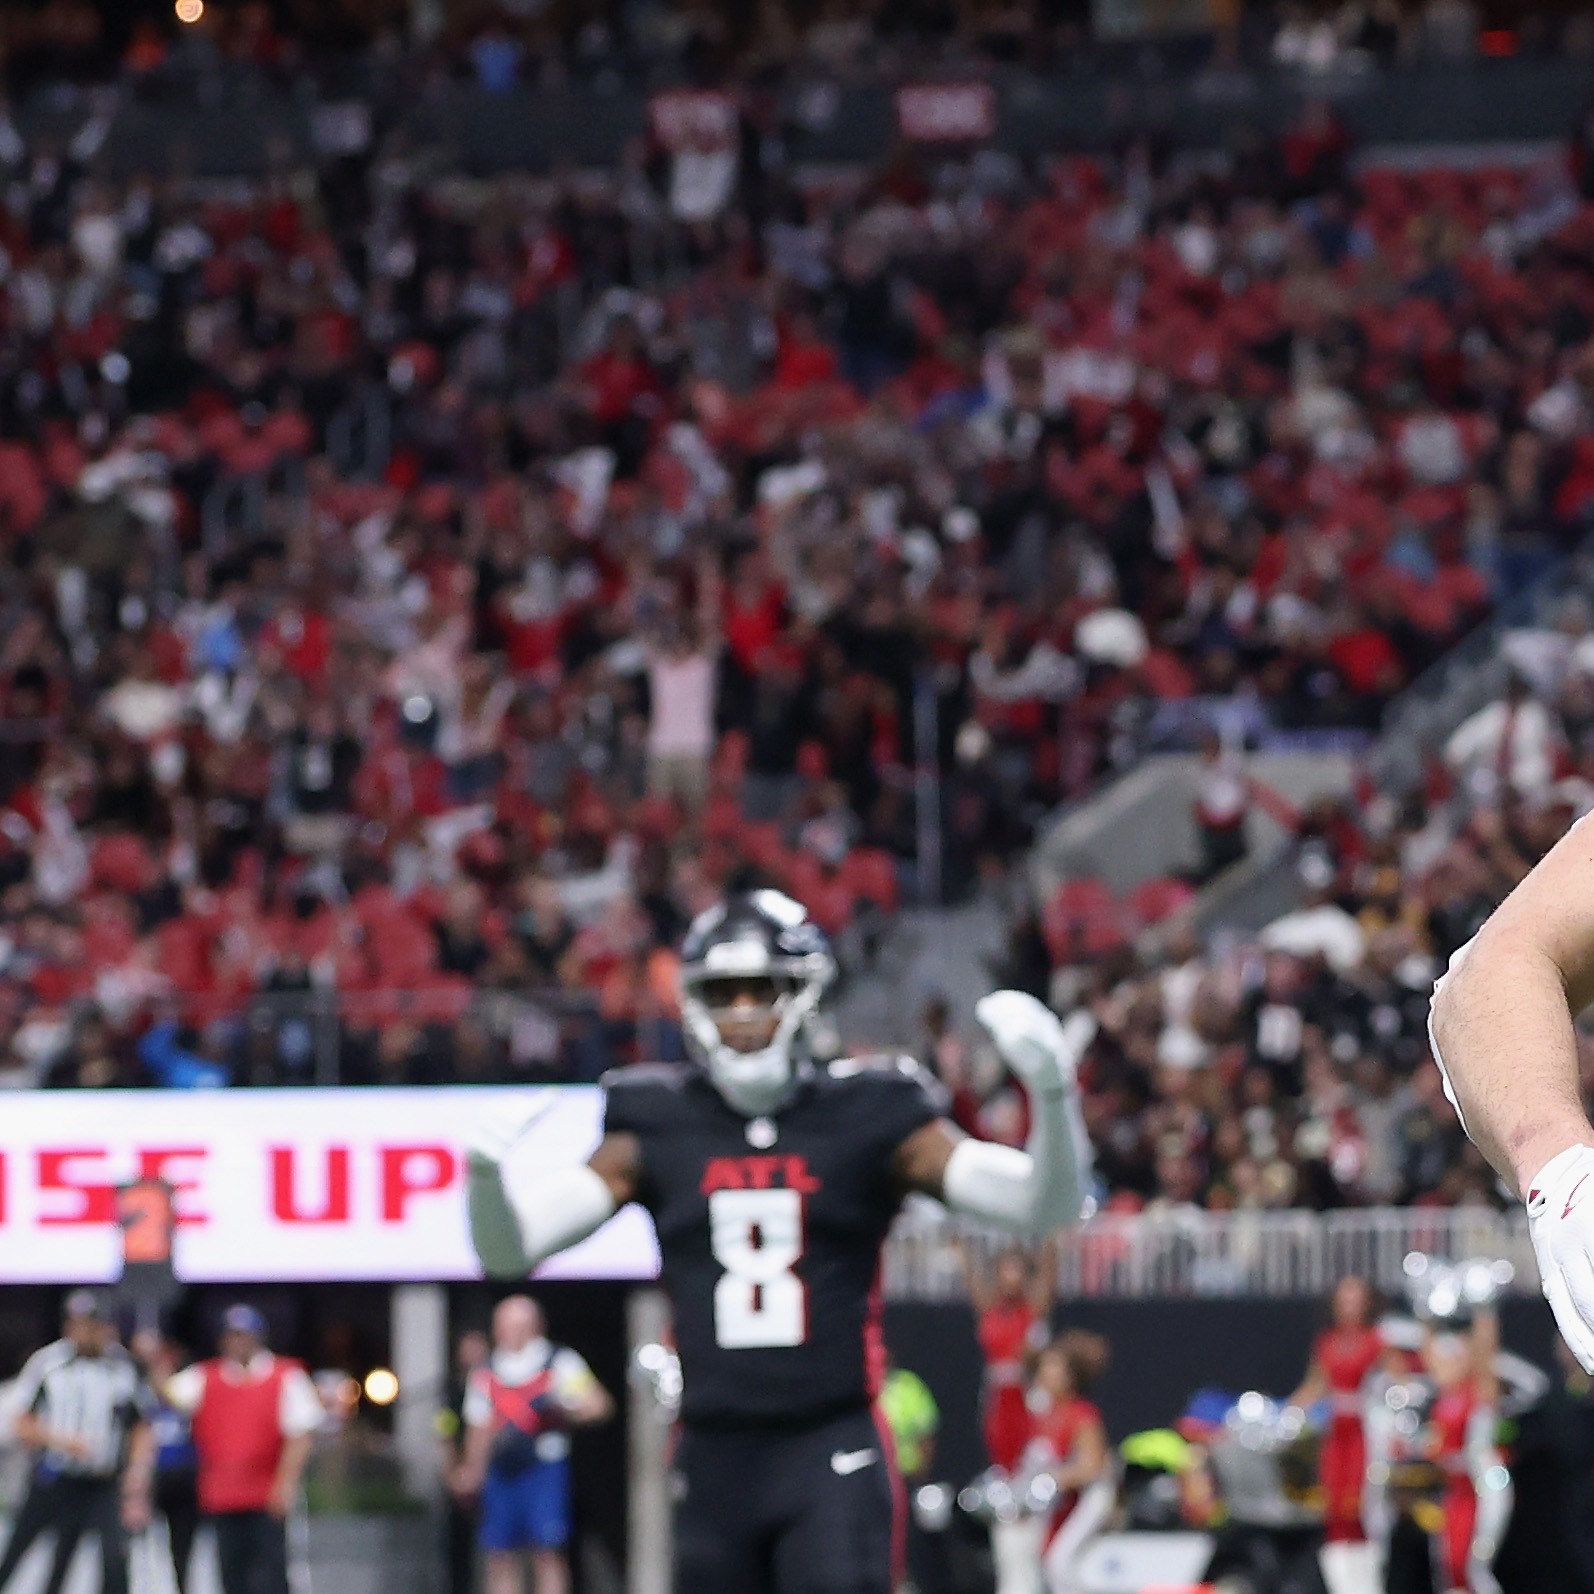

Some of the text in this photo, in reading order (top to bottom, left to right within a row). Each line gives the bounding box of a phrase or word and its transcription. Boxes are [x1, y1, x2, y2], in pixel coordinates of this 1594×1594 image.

[268, 1146, 464, 1224] UP
[703, 1155, 824, 1194] ATL
[708, 1188, 810, 1349] 8
